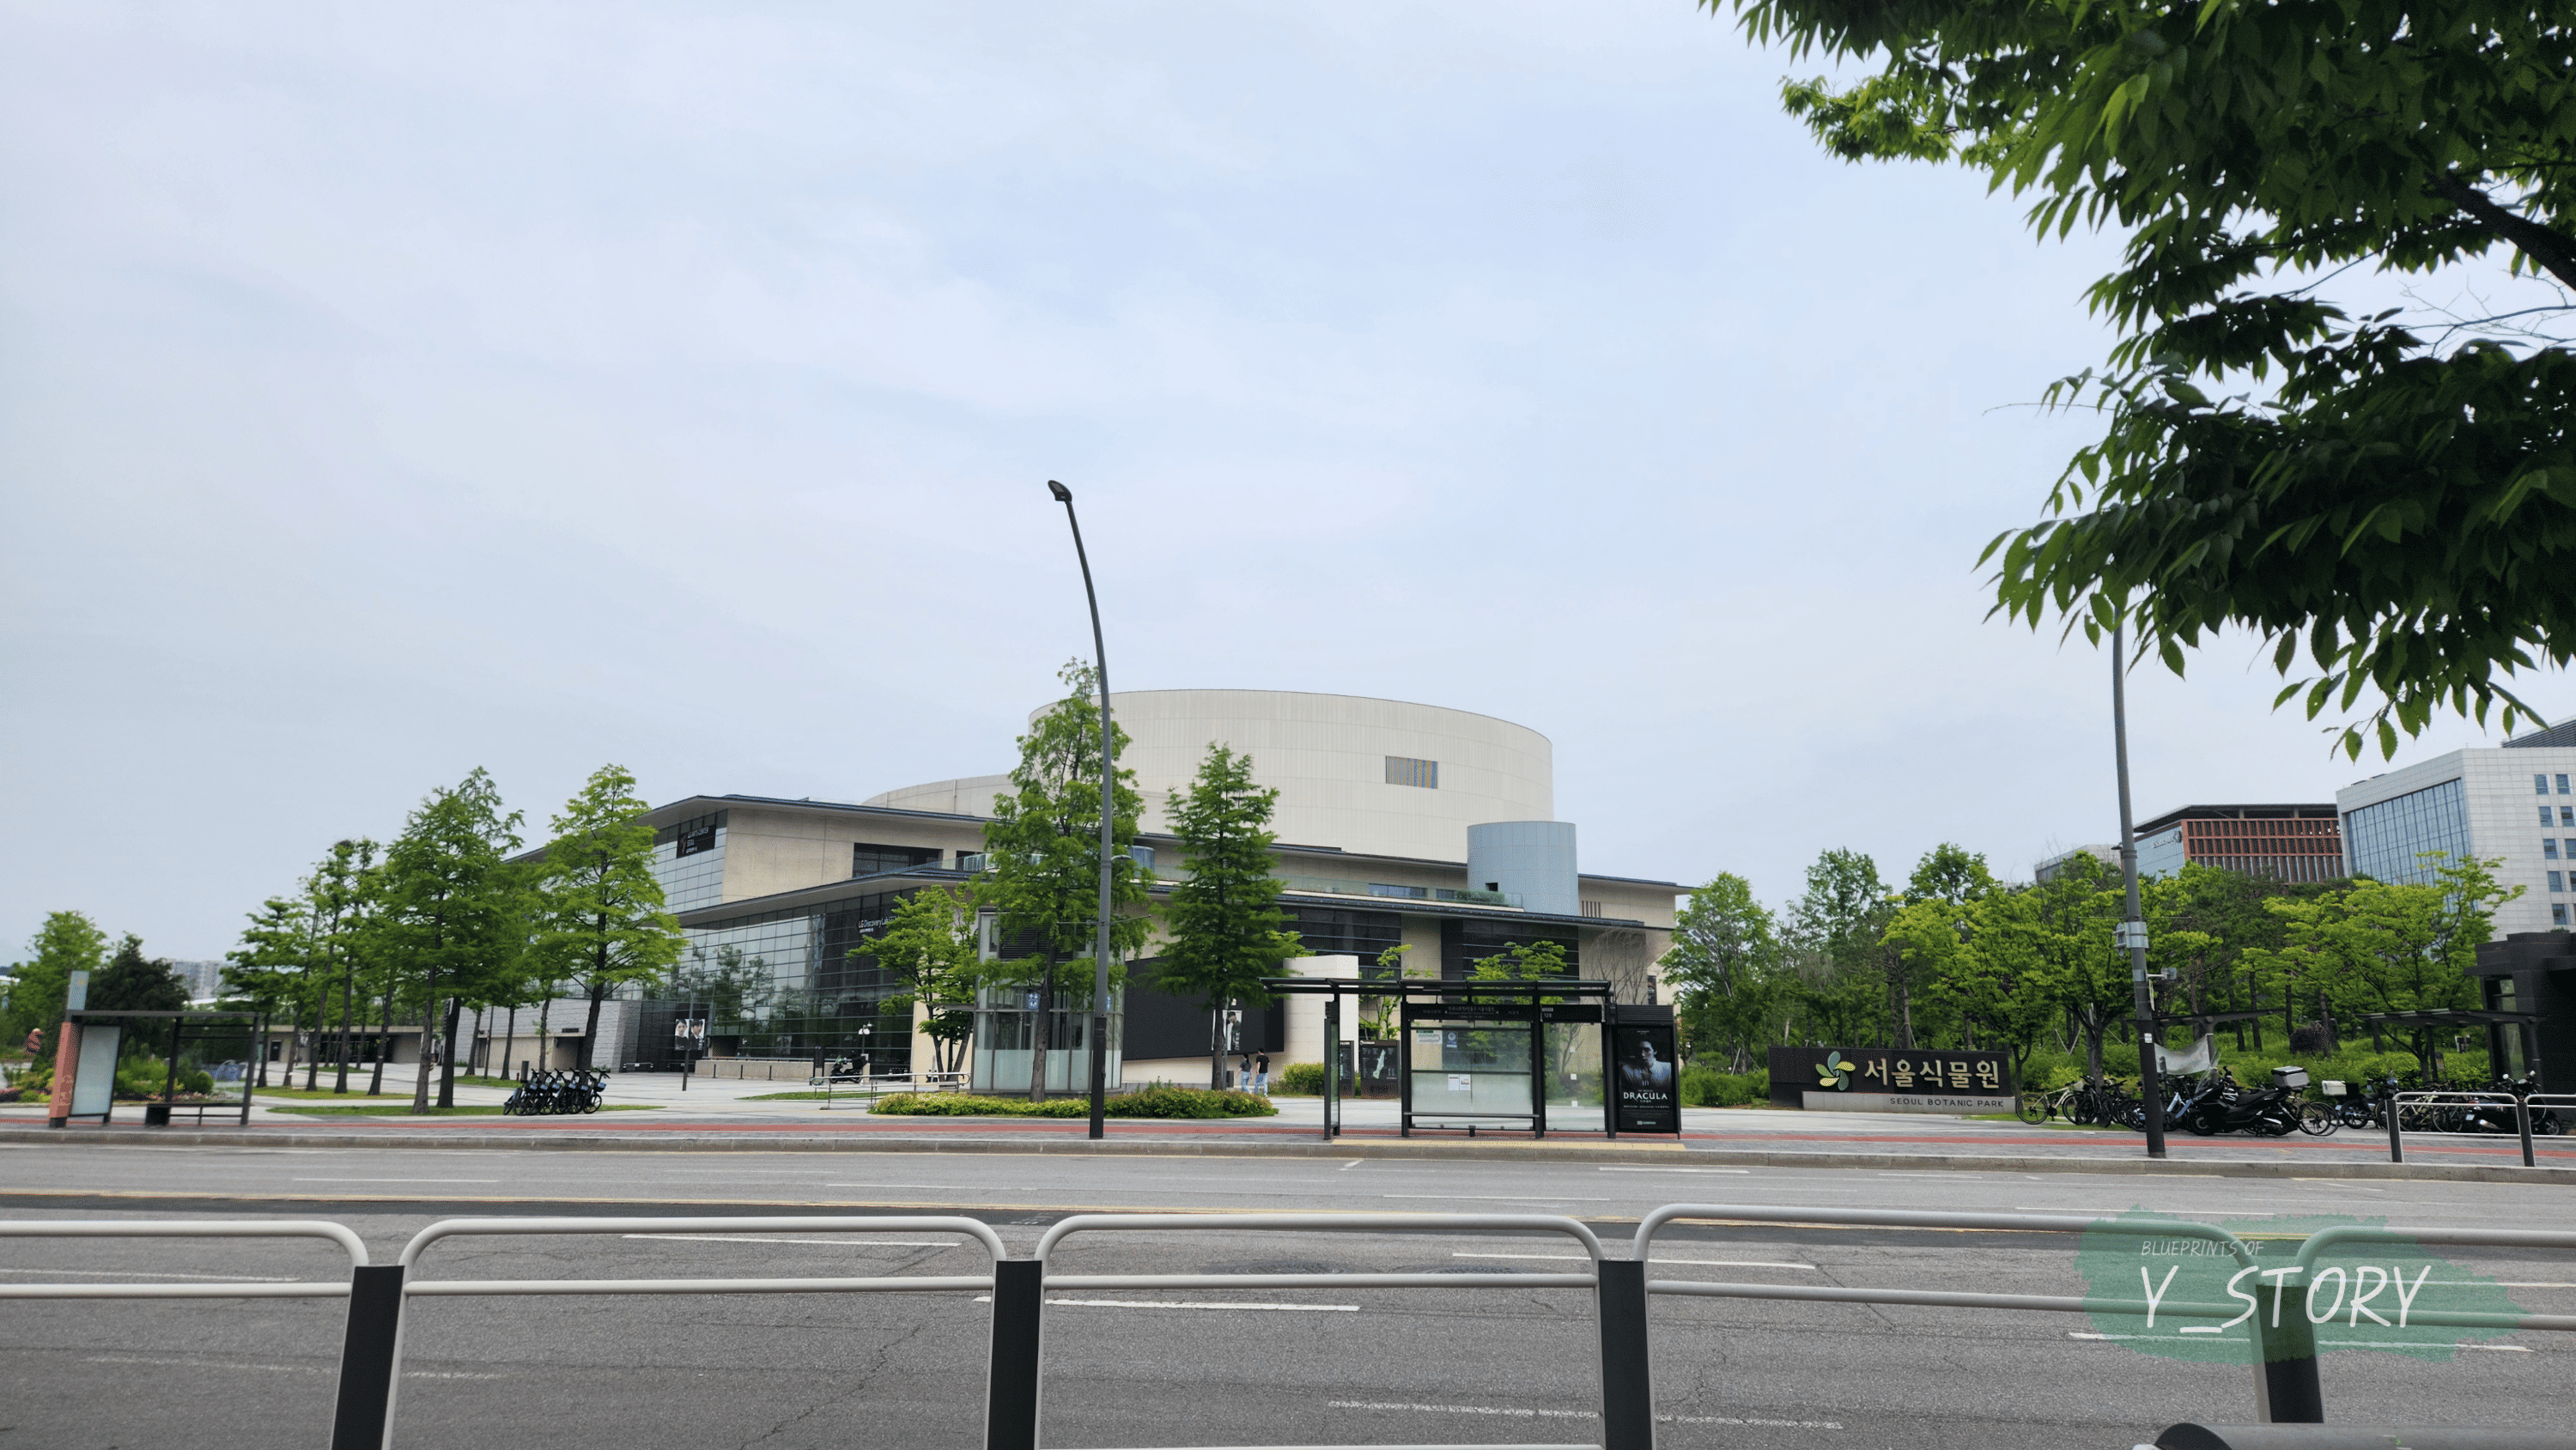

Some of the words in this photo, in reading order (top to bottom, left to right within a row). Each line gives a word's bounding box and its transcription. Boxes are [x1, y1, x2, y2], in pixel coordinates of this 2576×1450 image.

[859, 919, 864, 928] LG
[864, 919, 882, 928] Discovery
[1864, 1058, 2000, 1089] 서울식물원
[1623, 1091, 1668, 1101] DRACULA
[1890, 1097, 1923, 1106] SEOUL
[1928, 1098, 1973, 1107] BOTANIC
